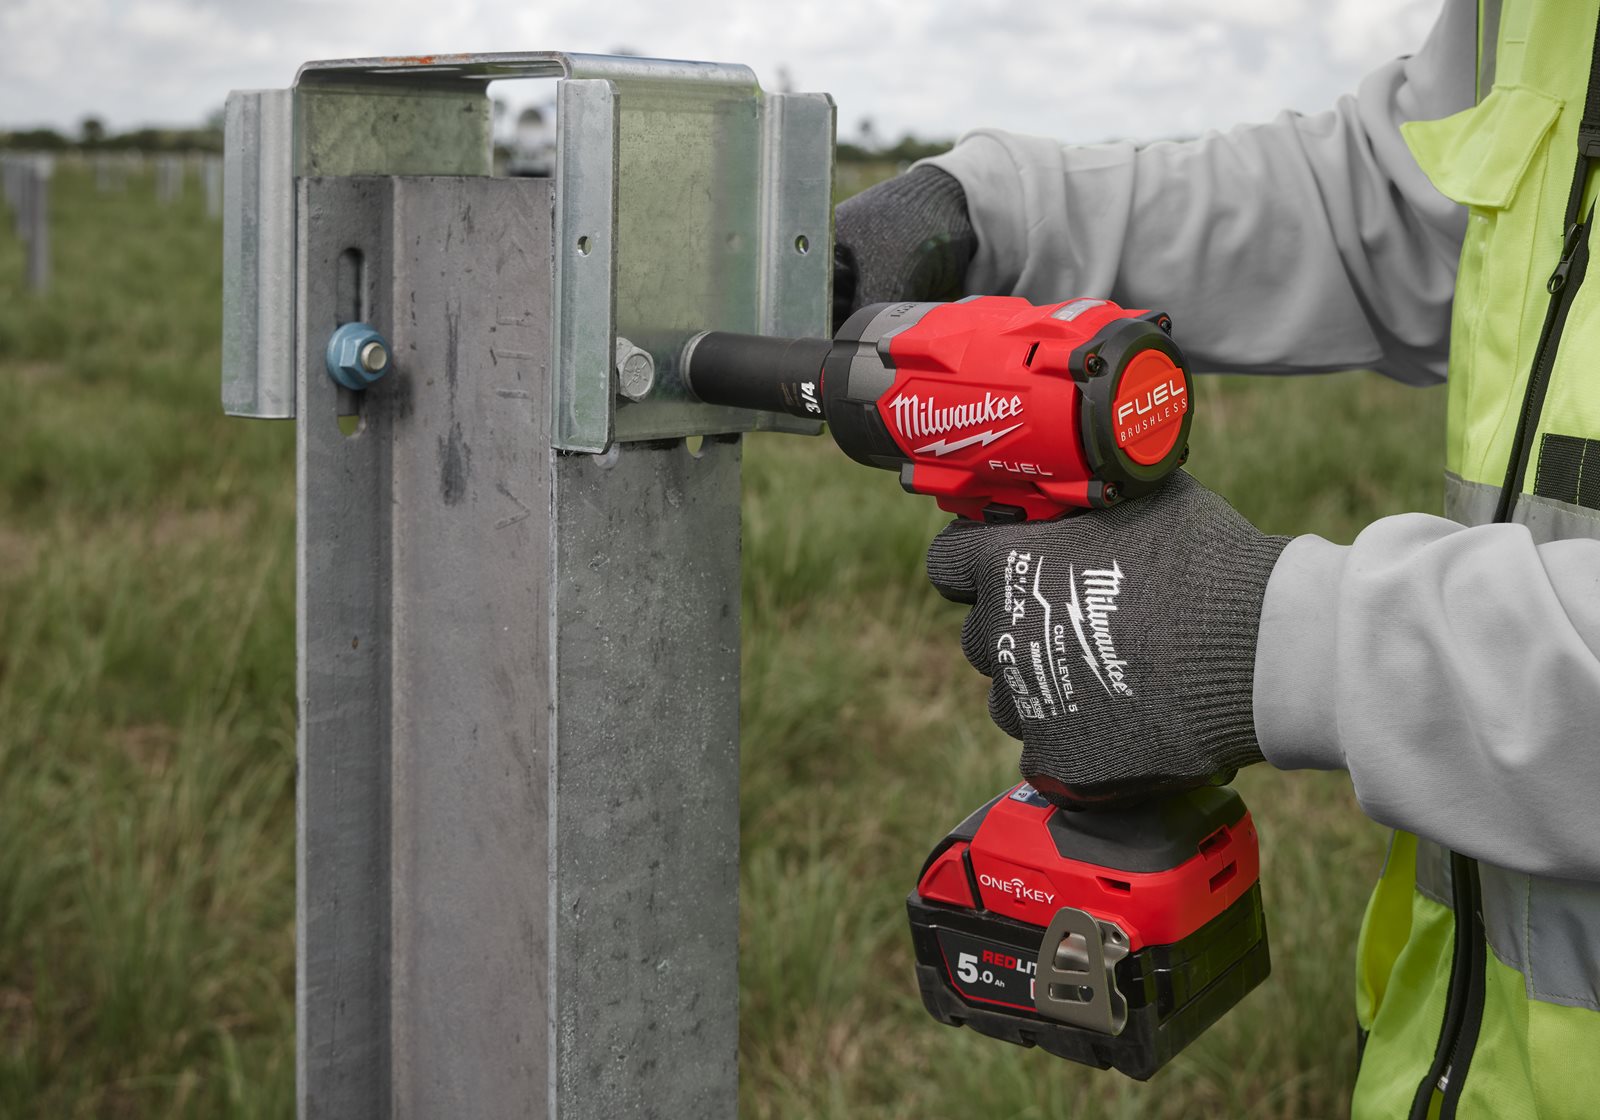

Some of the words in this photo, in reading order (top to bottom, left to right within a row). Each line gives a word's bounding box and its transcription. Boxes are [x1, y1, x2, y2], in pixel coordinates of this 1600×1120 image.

[801, 381, 821, 414] 3/4
[1118, 380, 1184, 425] FUEL
[889, 392, 1023, 440] Milwaukee
[1121, 398, 1187, 442] BRUSHLESS
[988, 460, 1053, 476] FUEL
[1054, 625, 1065, 653] CUT
[1058, 659, 1073, 700] LEVEL
[1068, 704, 1078, 712] 5
[994, 979, 1005, 988] Ah
